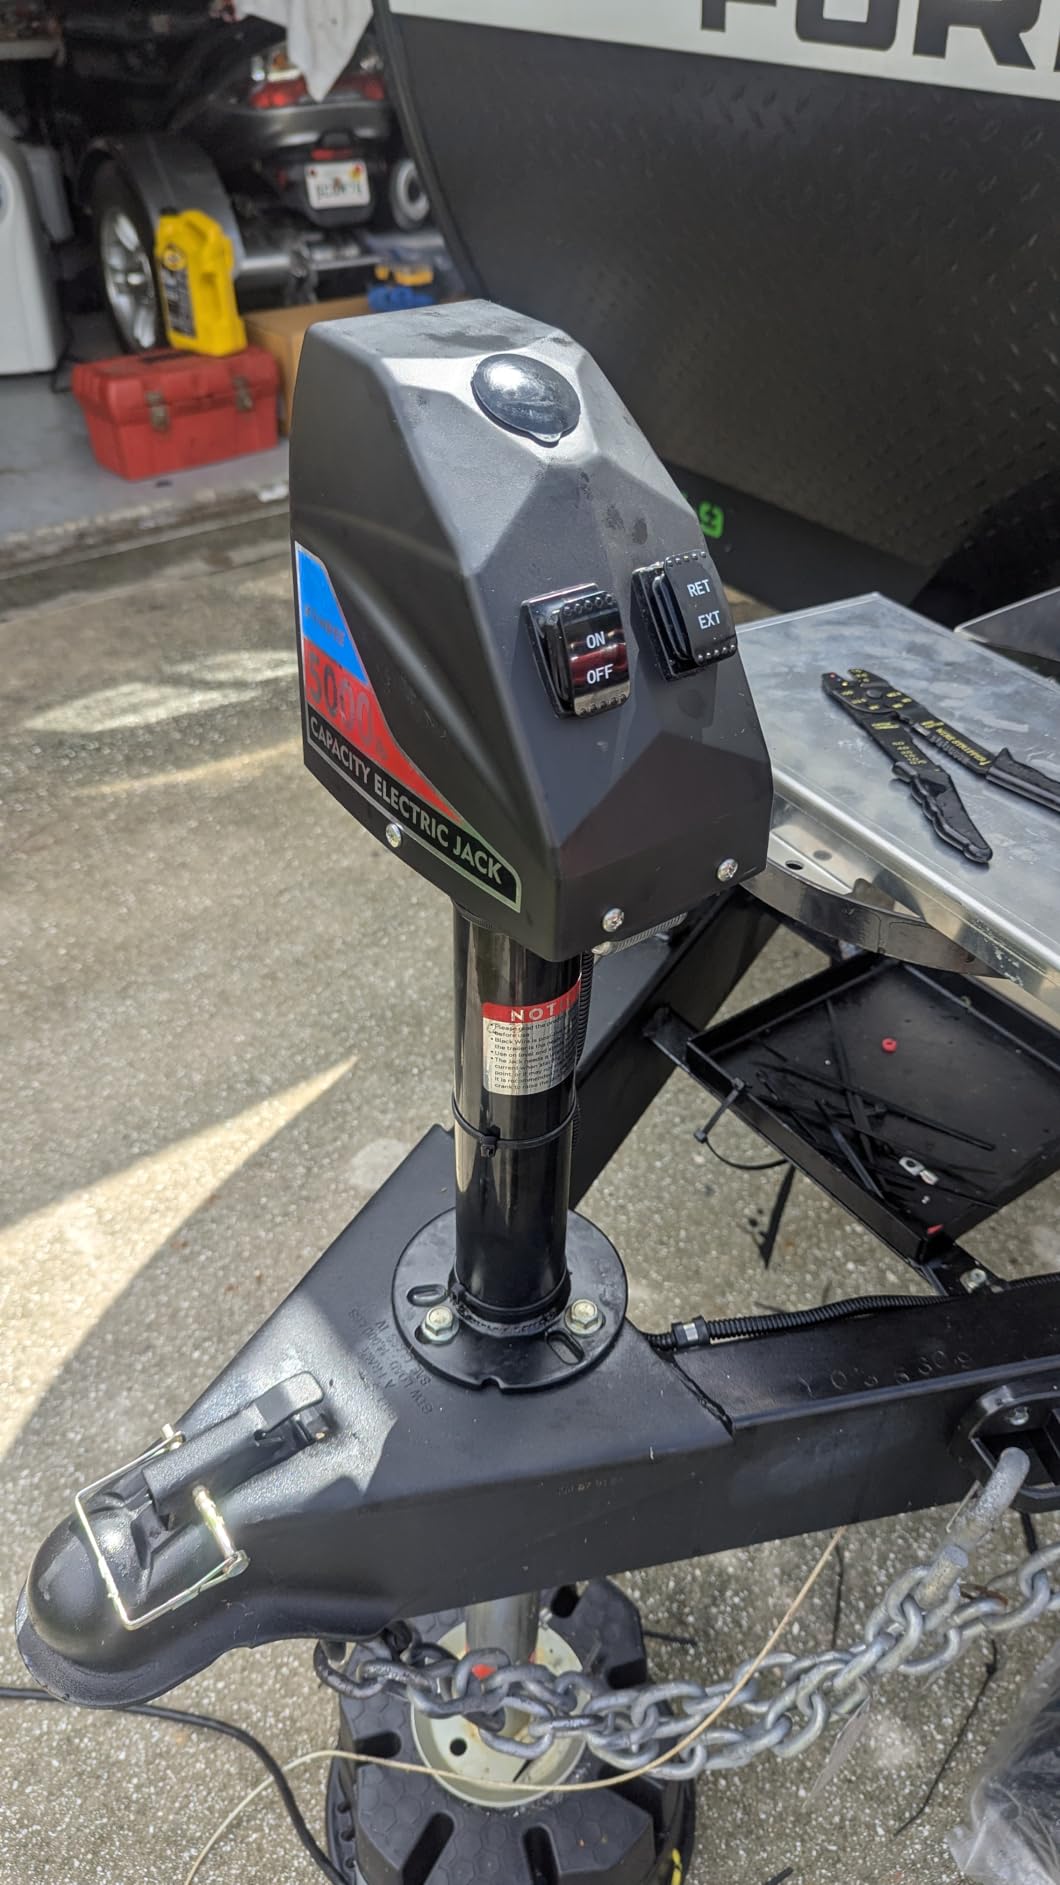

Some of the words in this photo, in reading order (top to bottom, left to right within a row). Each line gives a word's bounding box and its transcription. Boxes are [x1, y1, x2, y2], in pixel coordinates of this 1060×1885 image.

[687, 579, 711, 597] RET
[698, 611, 720, 630] EXT
[586, 631, 606, 649] ON
[586, 664, 613, 685] OFF
[310, 716, 371, 784] CAPACITY
[374, 772, 449, 848] ELECTRIC
[452, 835, 502, 885] JACK
